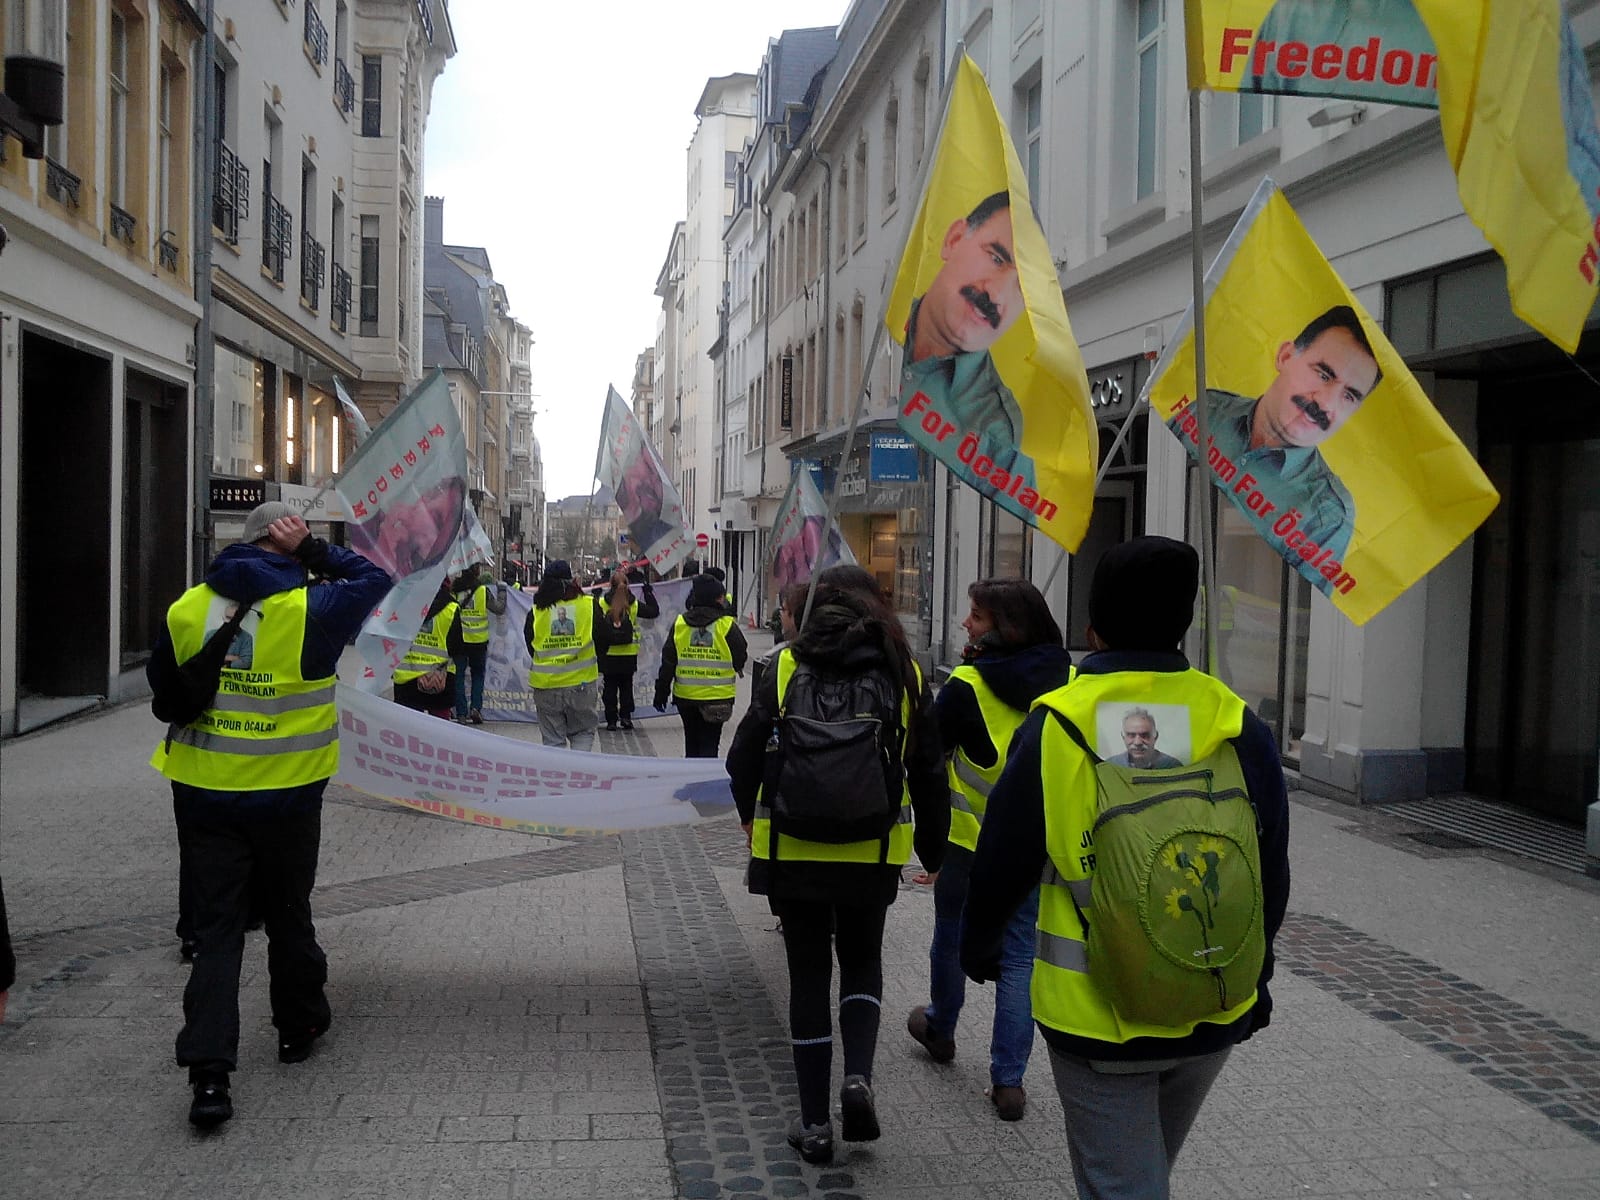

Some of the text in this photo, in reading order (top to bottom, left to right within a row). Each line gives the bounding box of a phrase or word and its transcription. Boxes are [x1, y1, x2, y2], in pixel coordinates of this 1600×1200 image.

[351, 422, 446, 520] FREEDOM
[902, 390, 1059, 522] For Öcalan
[213, 488, 262, 496] CLAUDIE
[213, 494, 262, 502] PIERLOT
[1233, 473, 1276, 520] For
[1272, 506, 1357, 596] Öcalan
[216, 718, 242, 731] POUR
